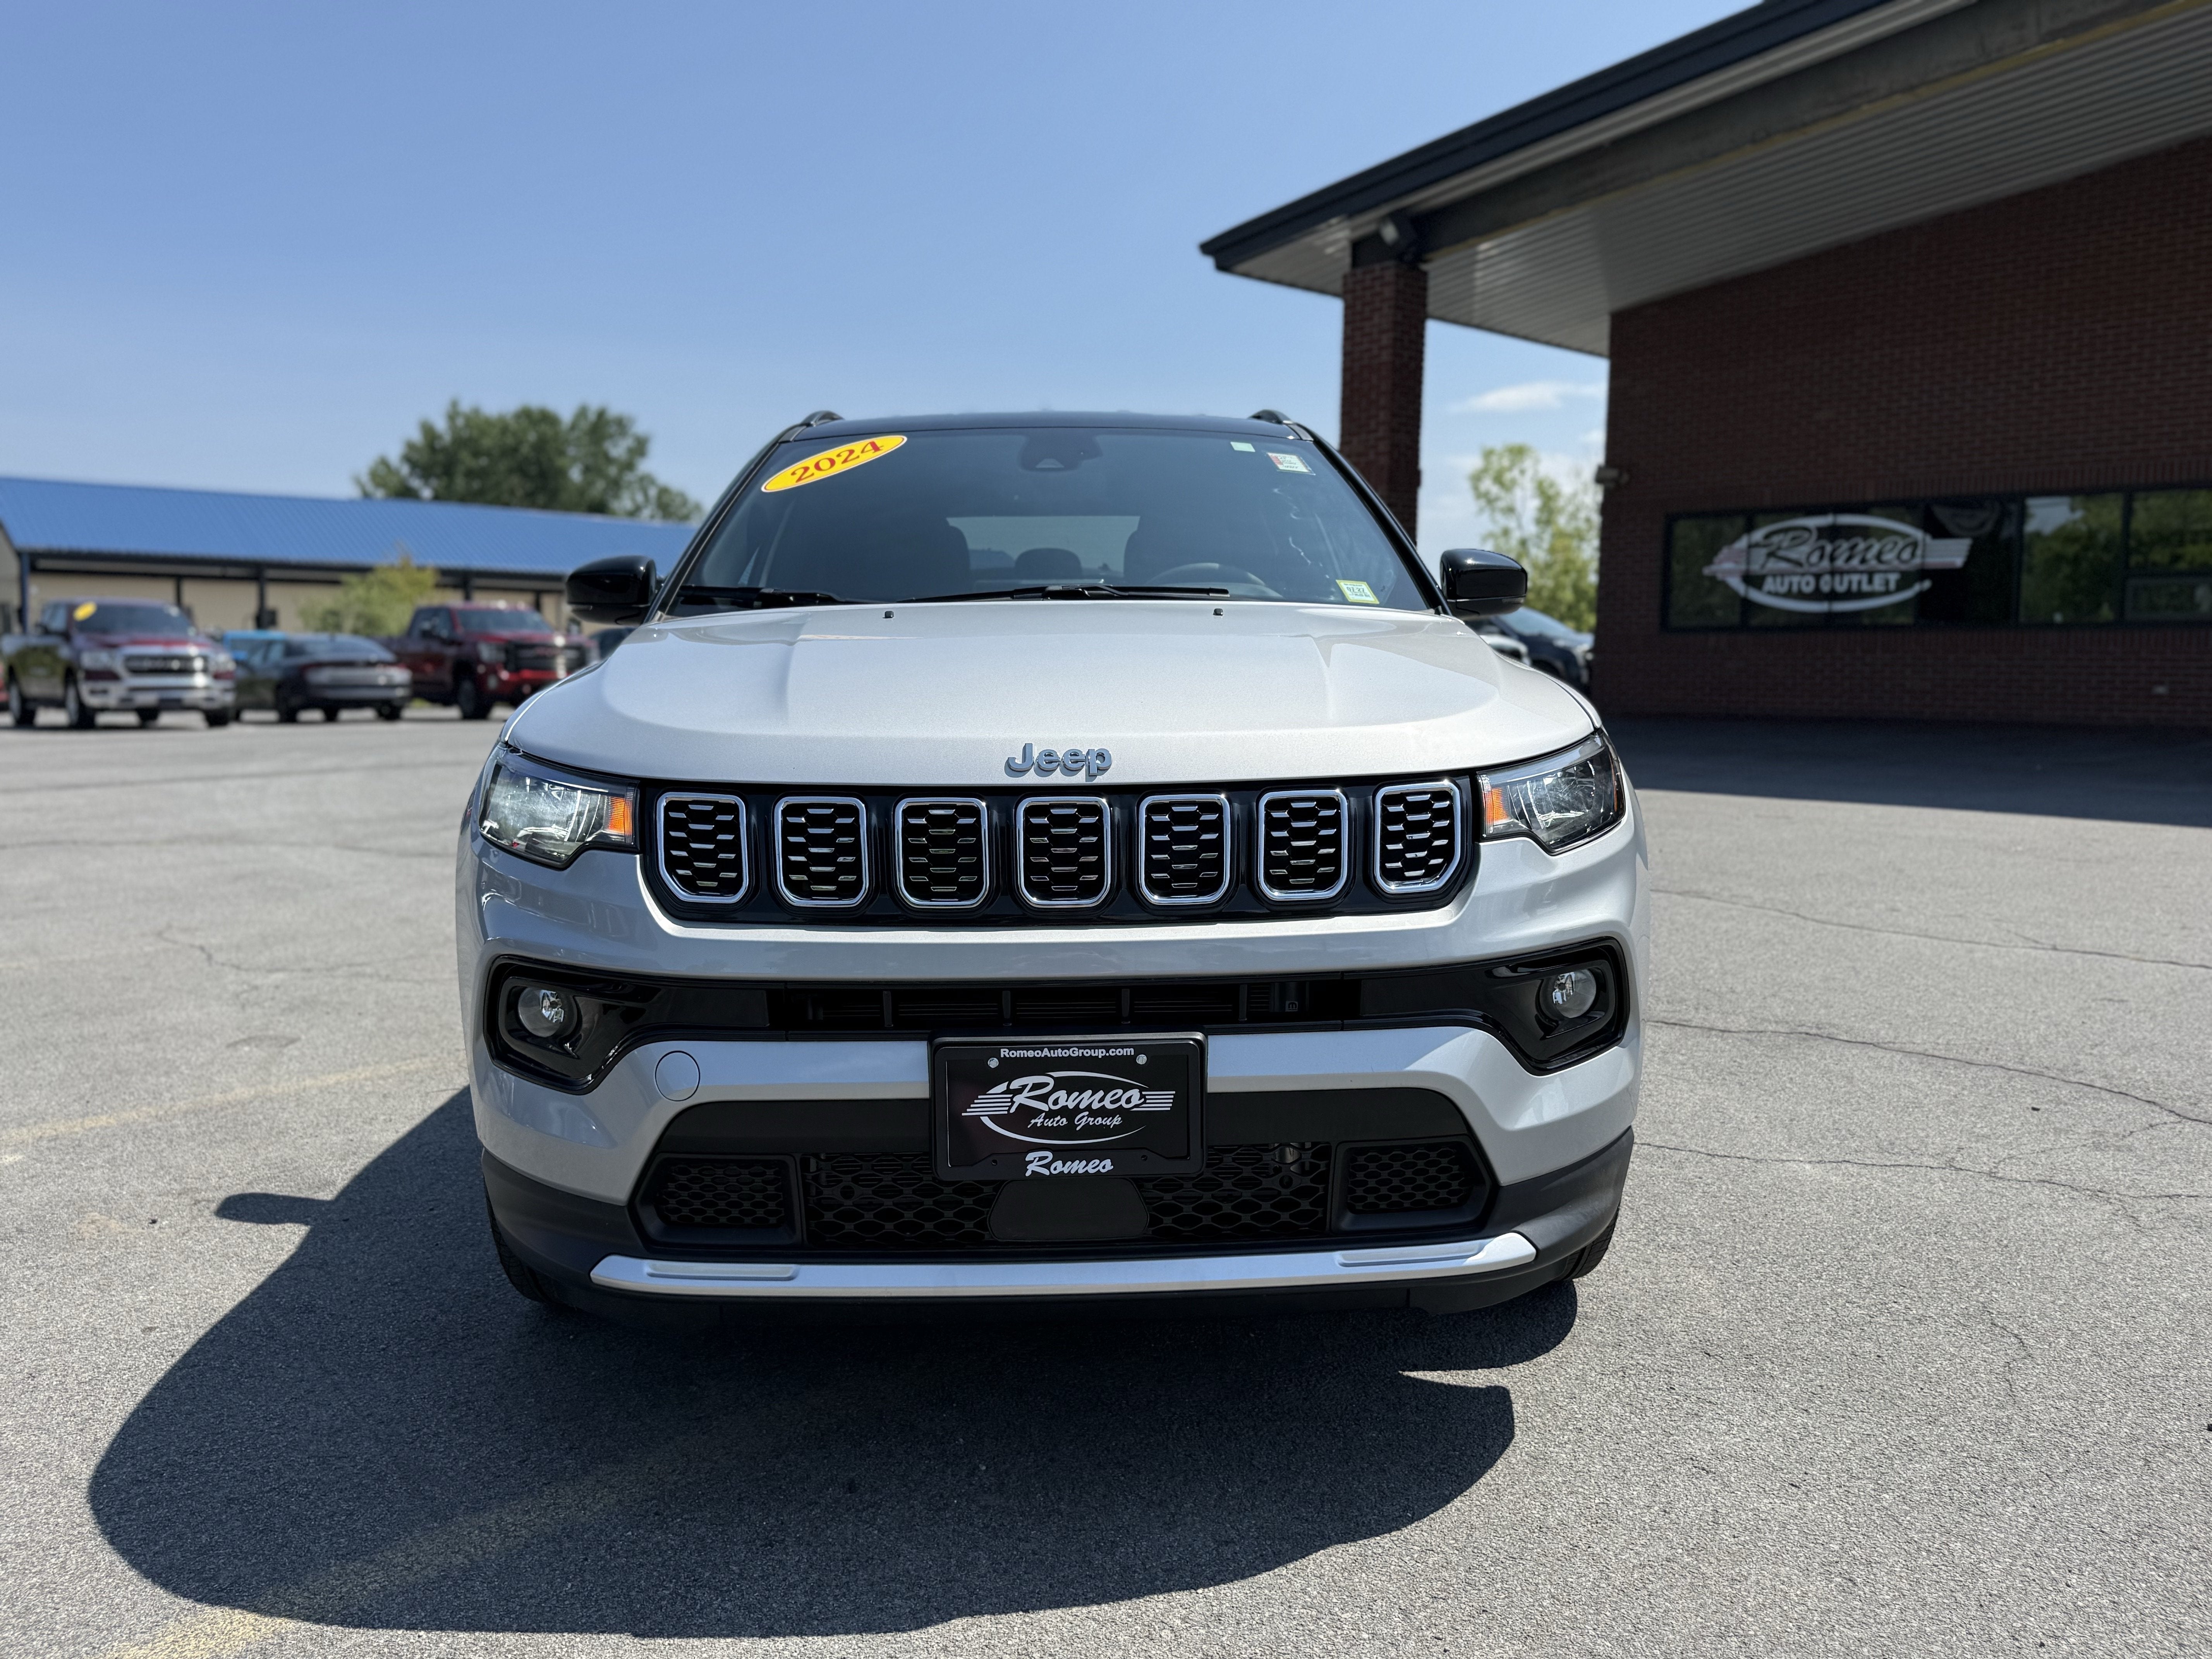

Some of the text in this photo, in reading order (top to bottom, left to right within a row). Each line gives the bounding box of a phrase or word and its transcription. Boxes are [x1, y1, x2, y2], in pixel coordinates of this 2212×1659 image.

[790, 441, 884, 483] 2024
[1747, 526, 1920, 569] Romeo
[1762, 572, 1901, 594] AUTO OUTLET
[1007, 743, 1112, 775] Jeep
[1000, 1047, 1134, 1058] RomeoAutoGroup.com
[1009, 1075, 1144, 1113] Romeo
[1027, 1111, 1123, 1130] Auto Group
[1025, 1151, 1114, 1177] Romeo
